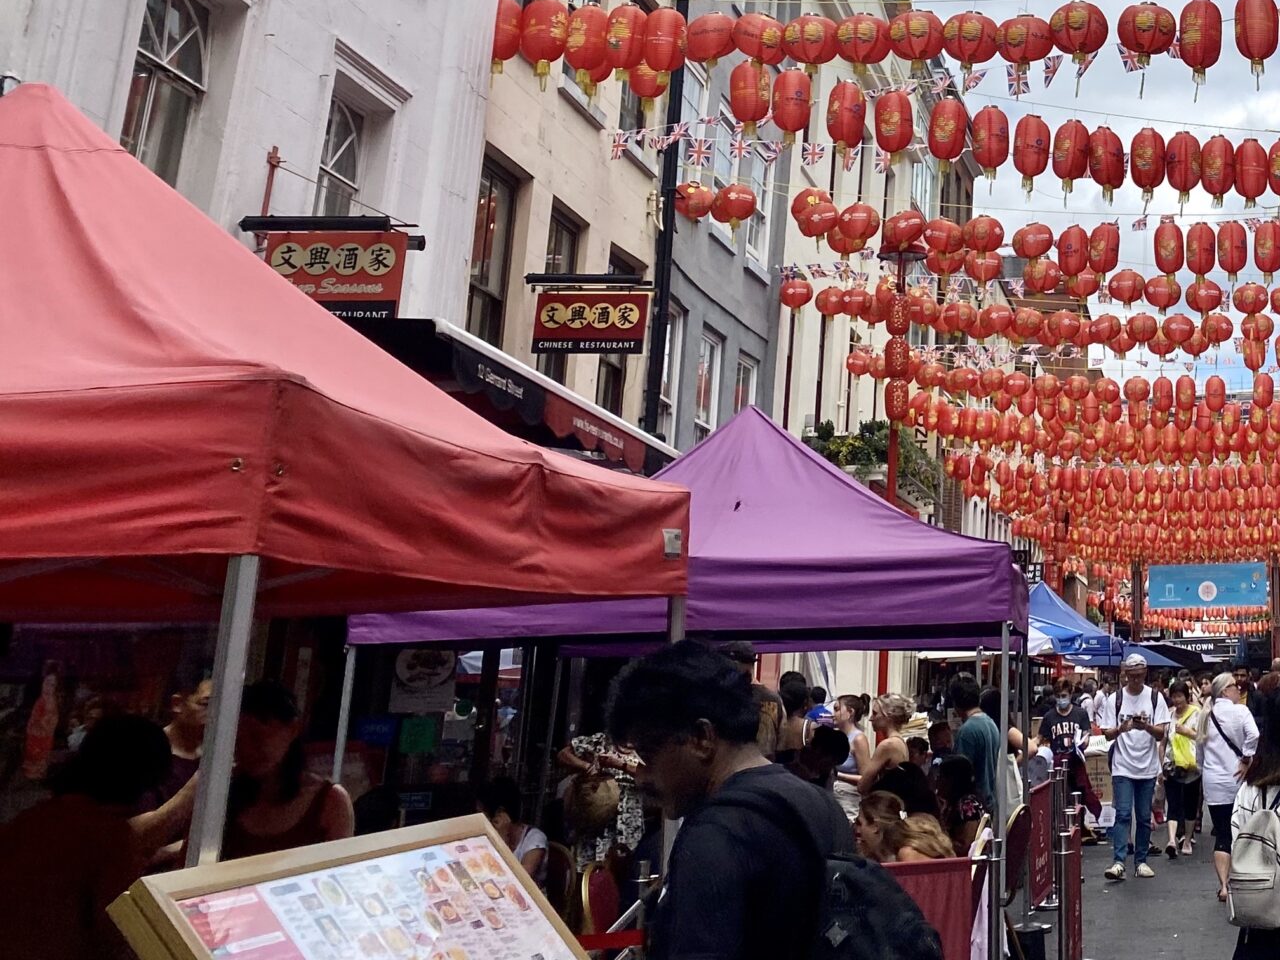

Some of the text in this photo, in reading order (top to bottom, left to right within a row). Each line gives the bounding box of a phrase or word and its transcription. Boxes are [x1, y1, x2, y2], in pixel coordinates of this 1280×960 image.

[274, 245, 391, 272] 文興酒家
[318, 277, 384, 294] Seasons
[543, 305, 635, 327] 文興酒家
[538, 341, 636, 349] CHINESE RESTAURANT
[1051, 721, 1081, 740] PARIS
